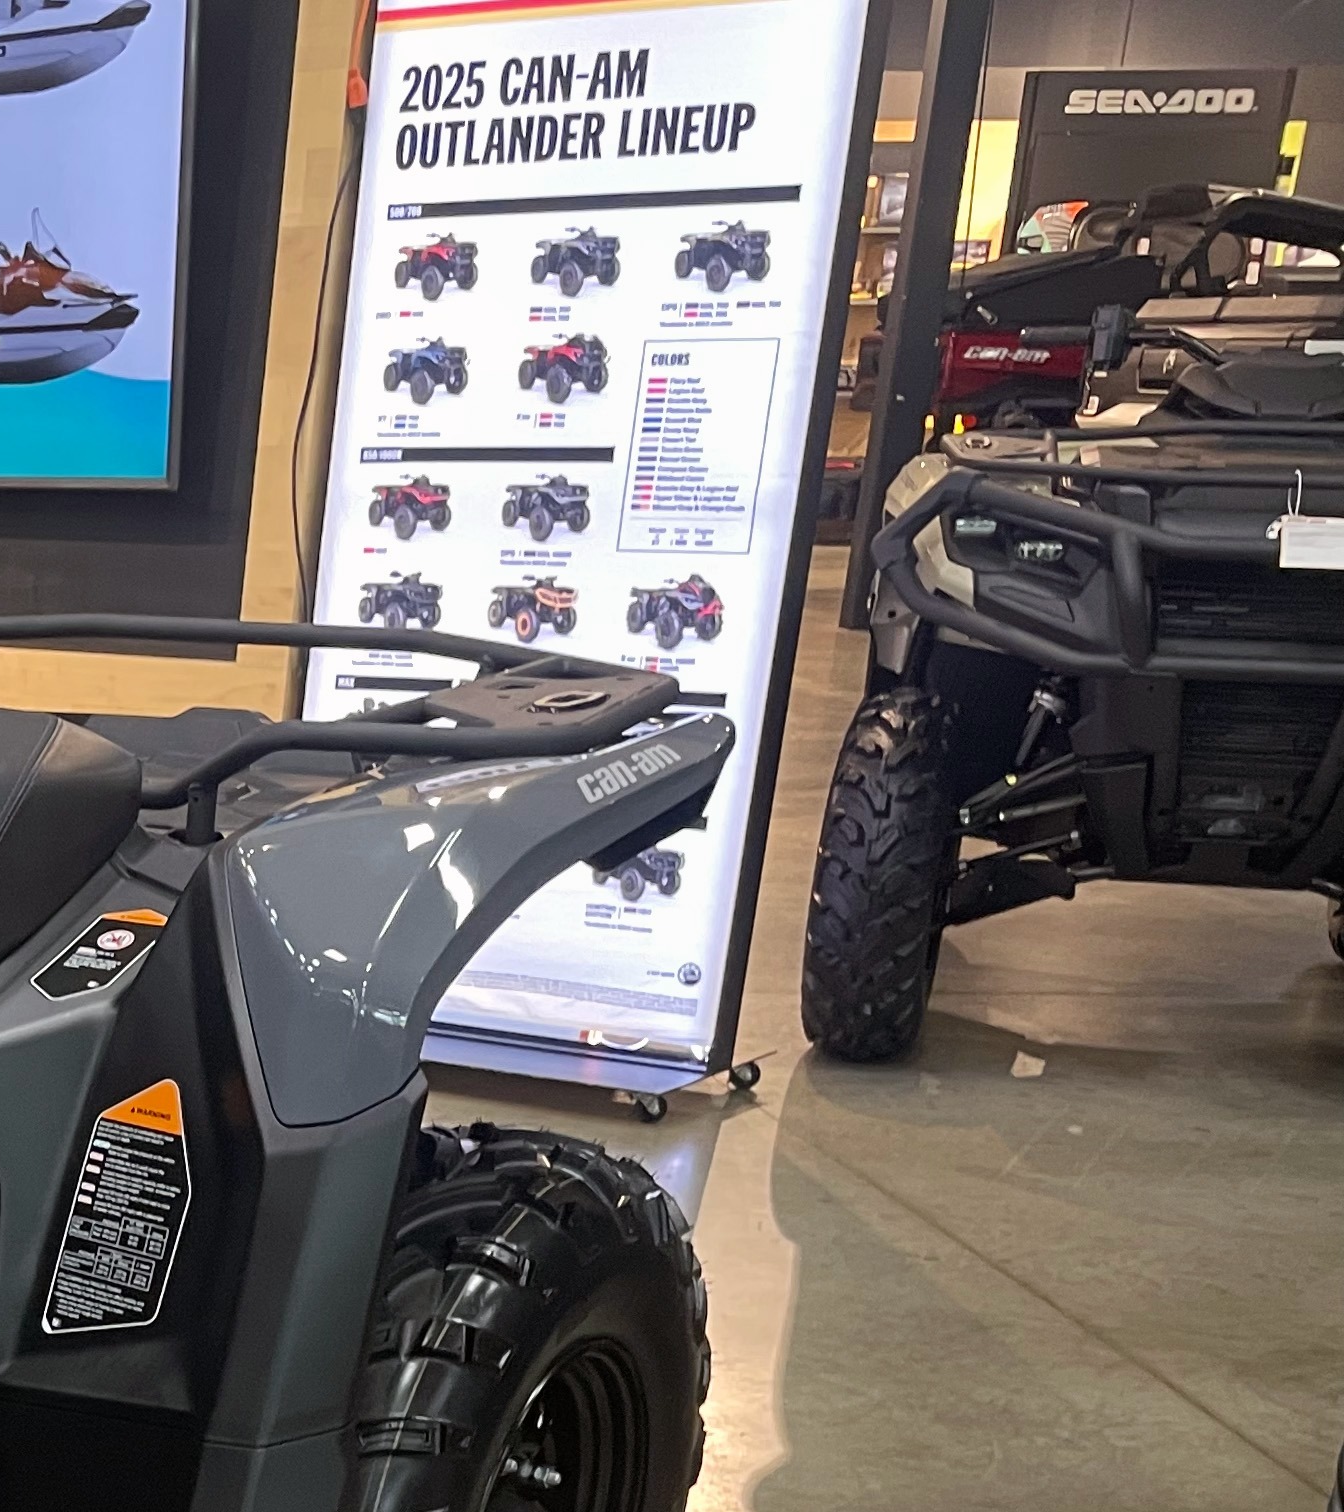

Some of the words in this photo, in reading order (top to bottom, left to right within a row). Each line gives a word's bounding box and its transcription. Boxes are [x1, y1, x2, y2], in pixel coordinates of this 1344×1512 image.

[399, 59, 488, 114] 2025
[499, 47, 651, 107] CAN-AM
[395, 110, 607, 171] OUTLANDER
[616, 102, 757, 159] LINEUP
[650, 352, 691, 367] COLORS
